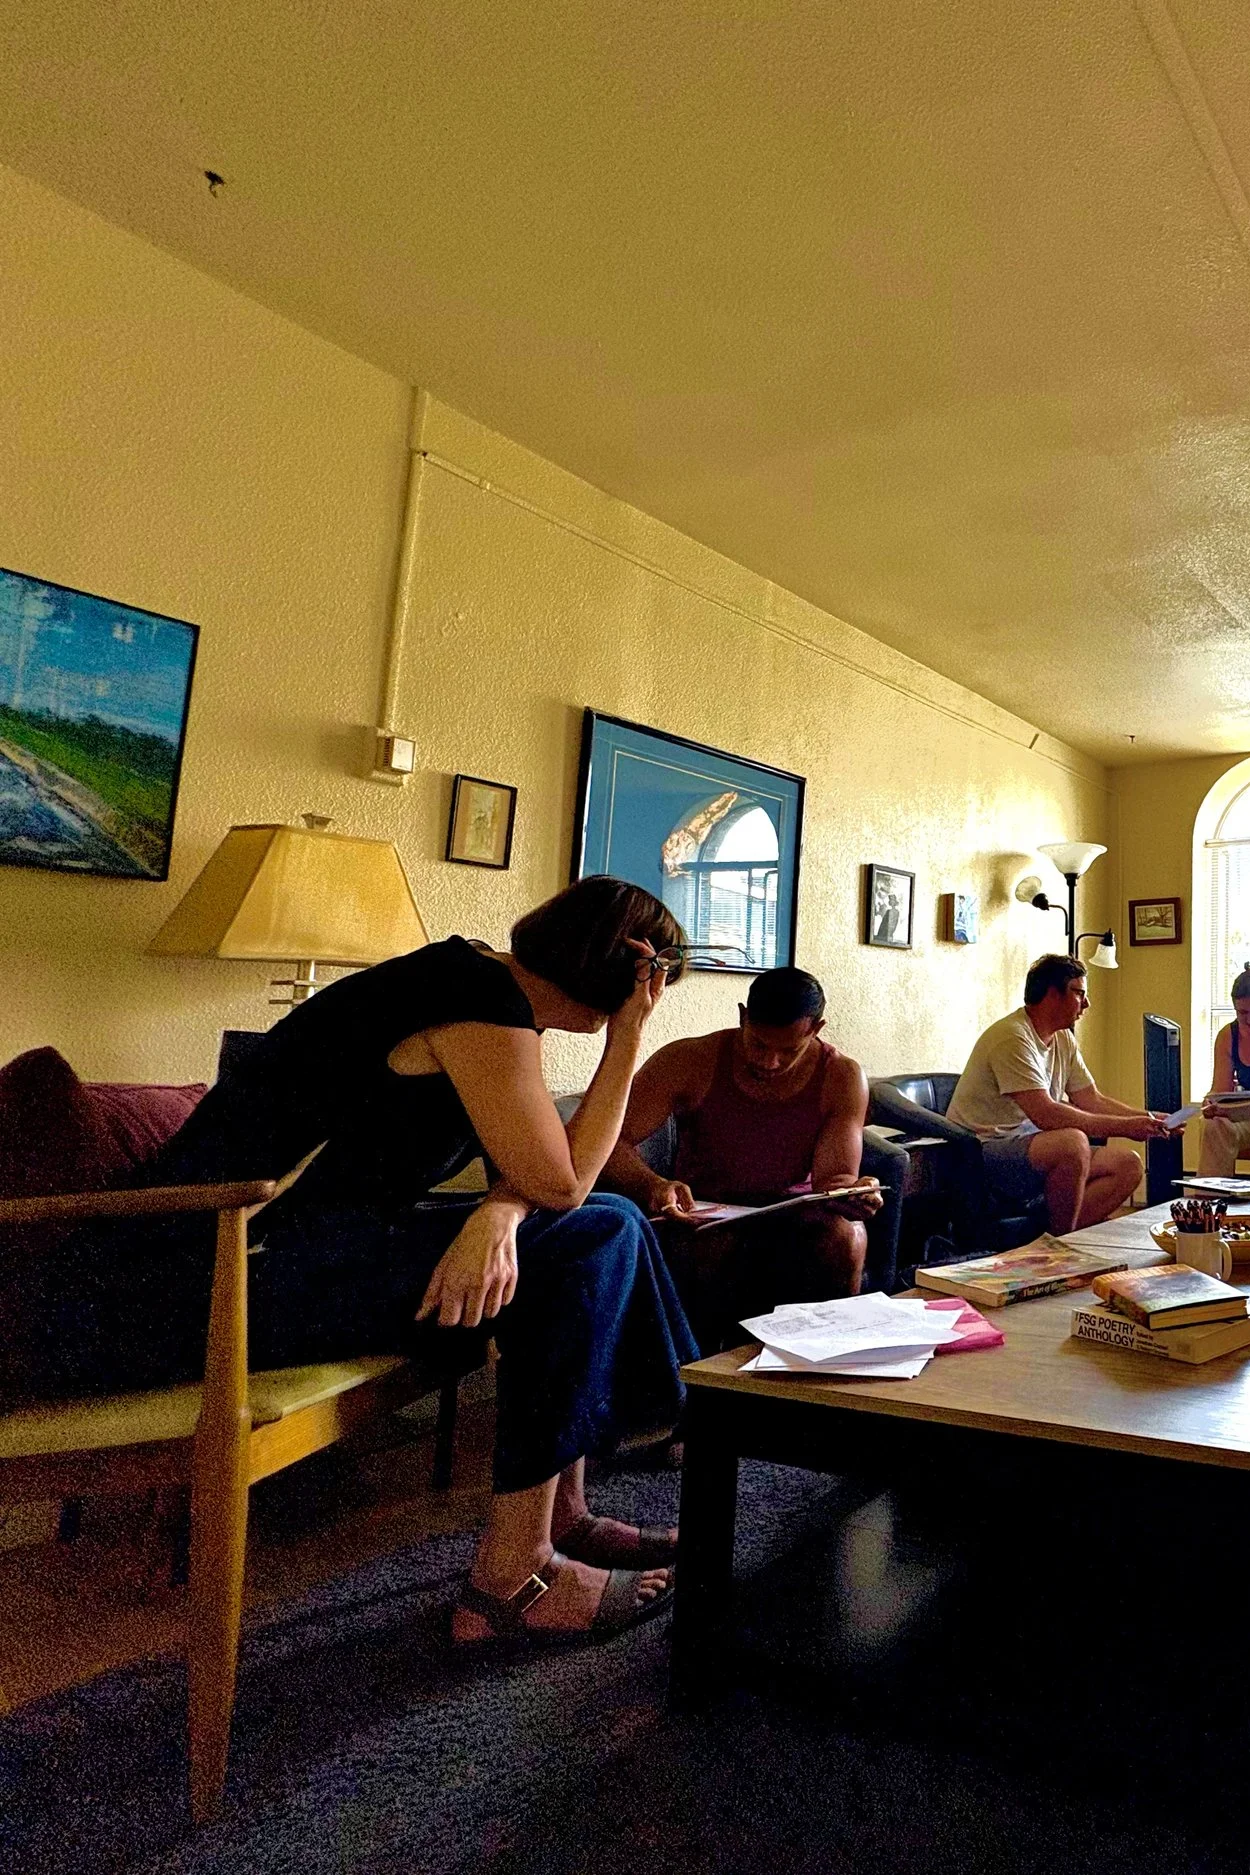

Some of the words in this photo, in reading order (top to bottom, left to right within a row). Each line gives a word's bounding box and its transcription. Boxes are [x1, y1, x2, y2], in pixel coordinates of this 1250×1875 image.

[1078, 1312, 1097, 1326] FSG
[1098, 1317, 1136, 1335] POETRY
[1078, 1325, 1135, 1347] ANTHOLOGY
